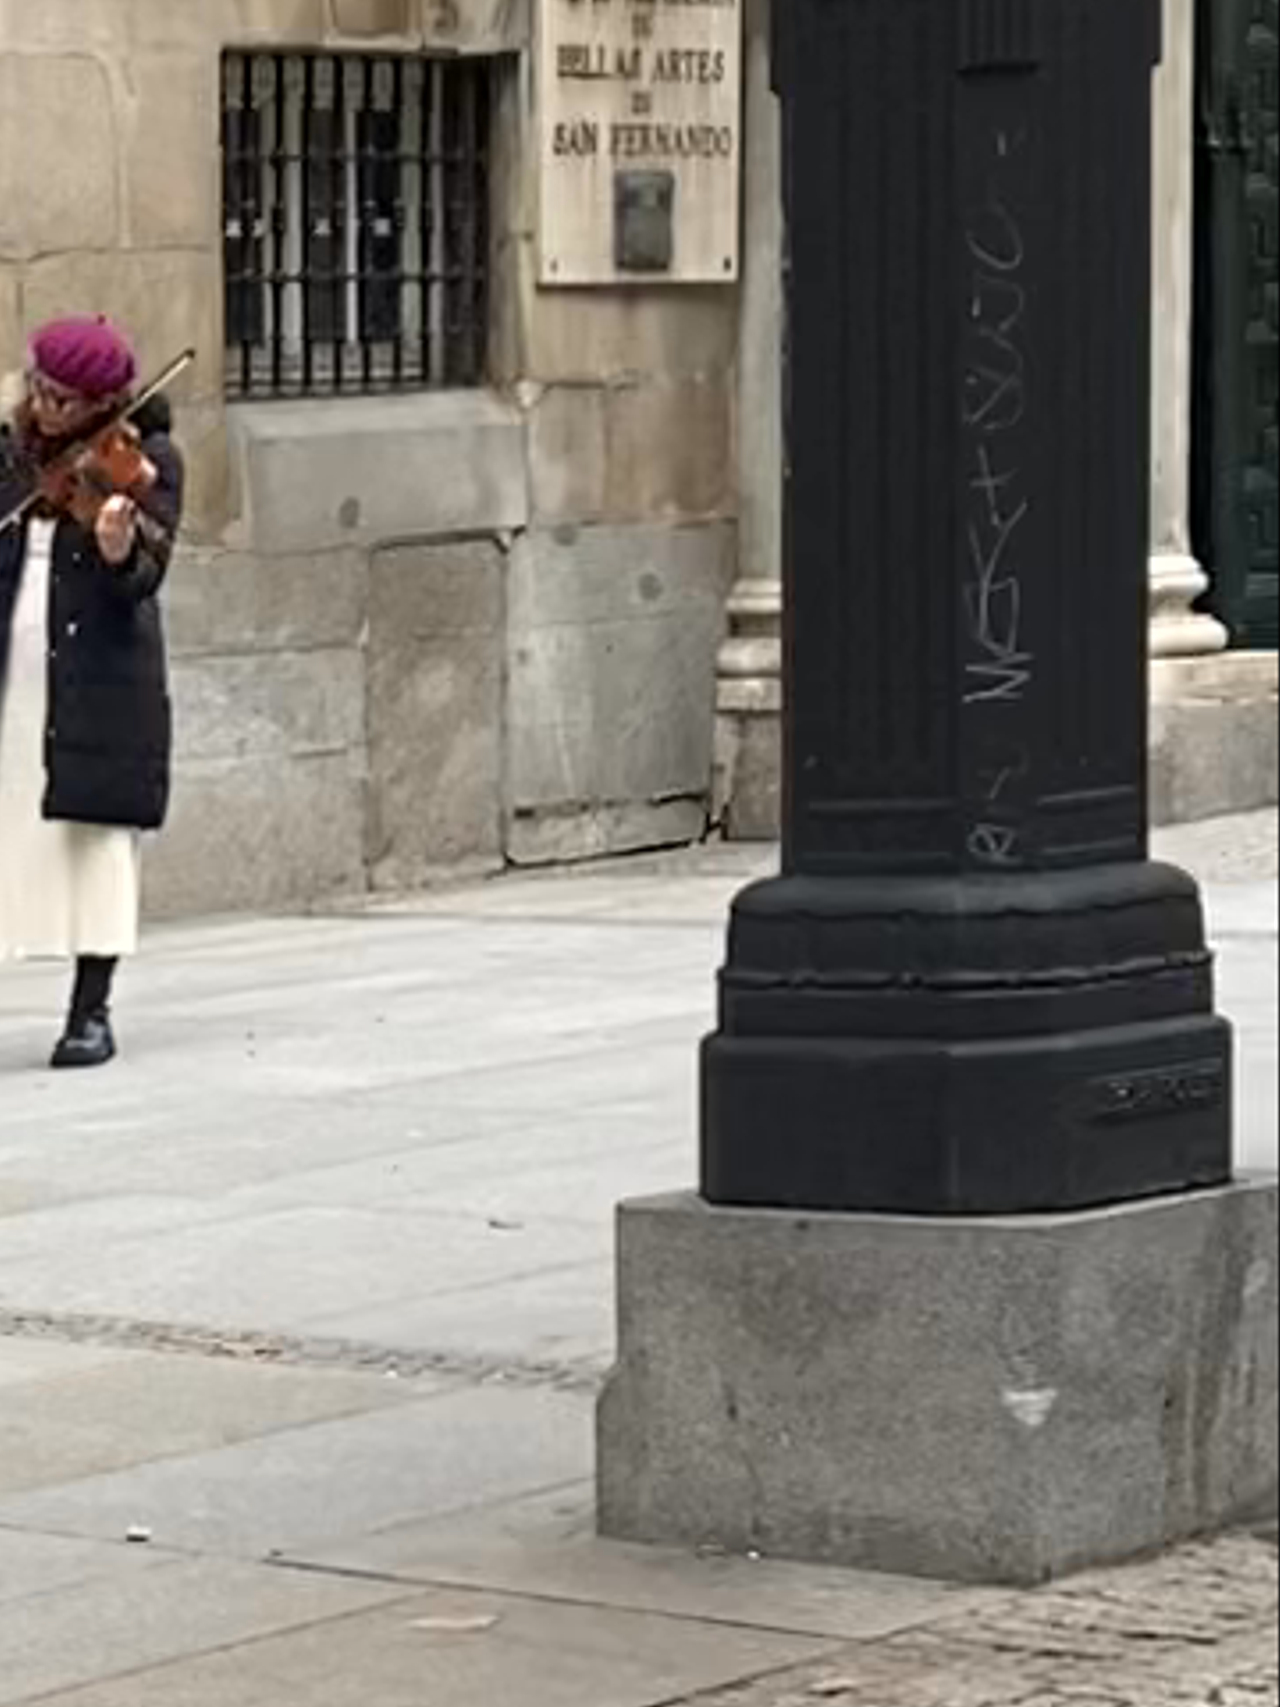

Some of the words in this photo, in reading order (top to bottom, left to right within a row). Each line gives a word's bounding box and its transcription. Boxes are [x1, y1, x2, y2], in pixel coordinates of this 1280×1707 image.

[651, 49, 726, 84] ARTES
[553, 120, 598, 158] SAN
[610, 122, 731, 159] FERNANDO
